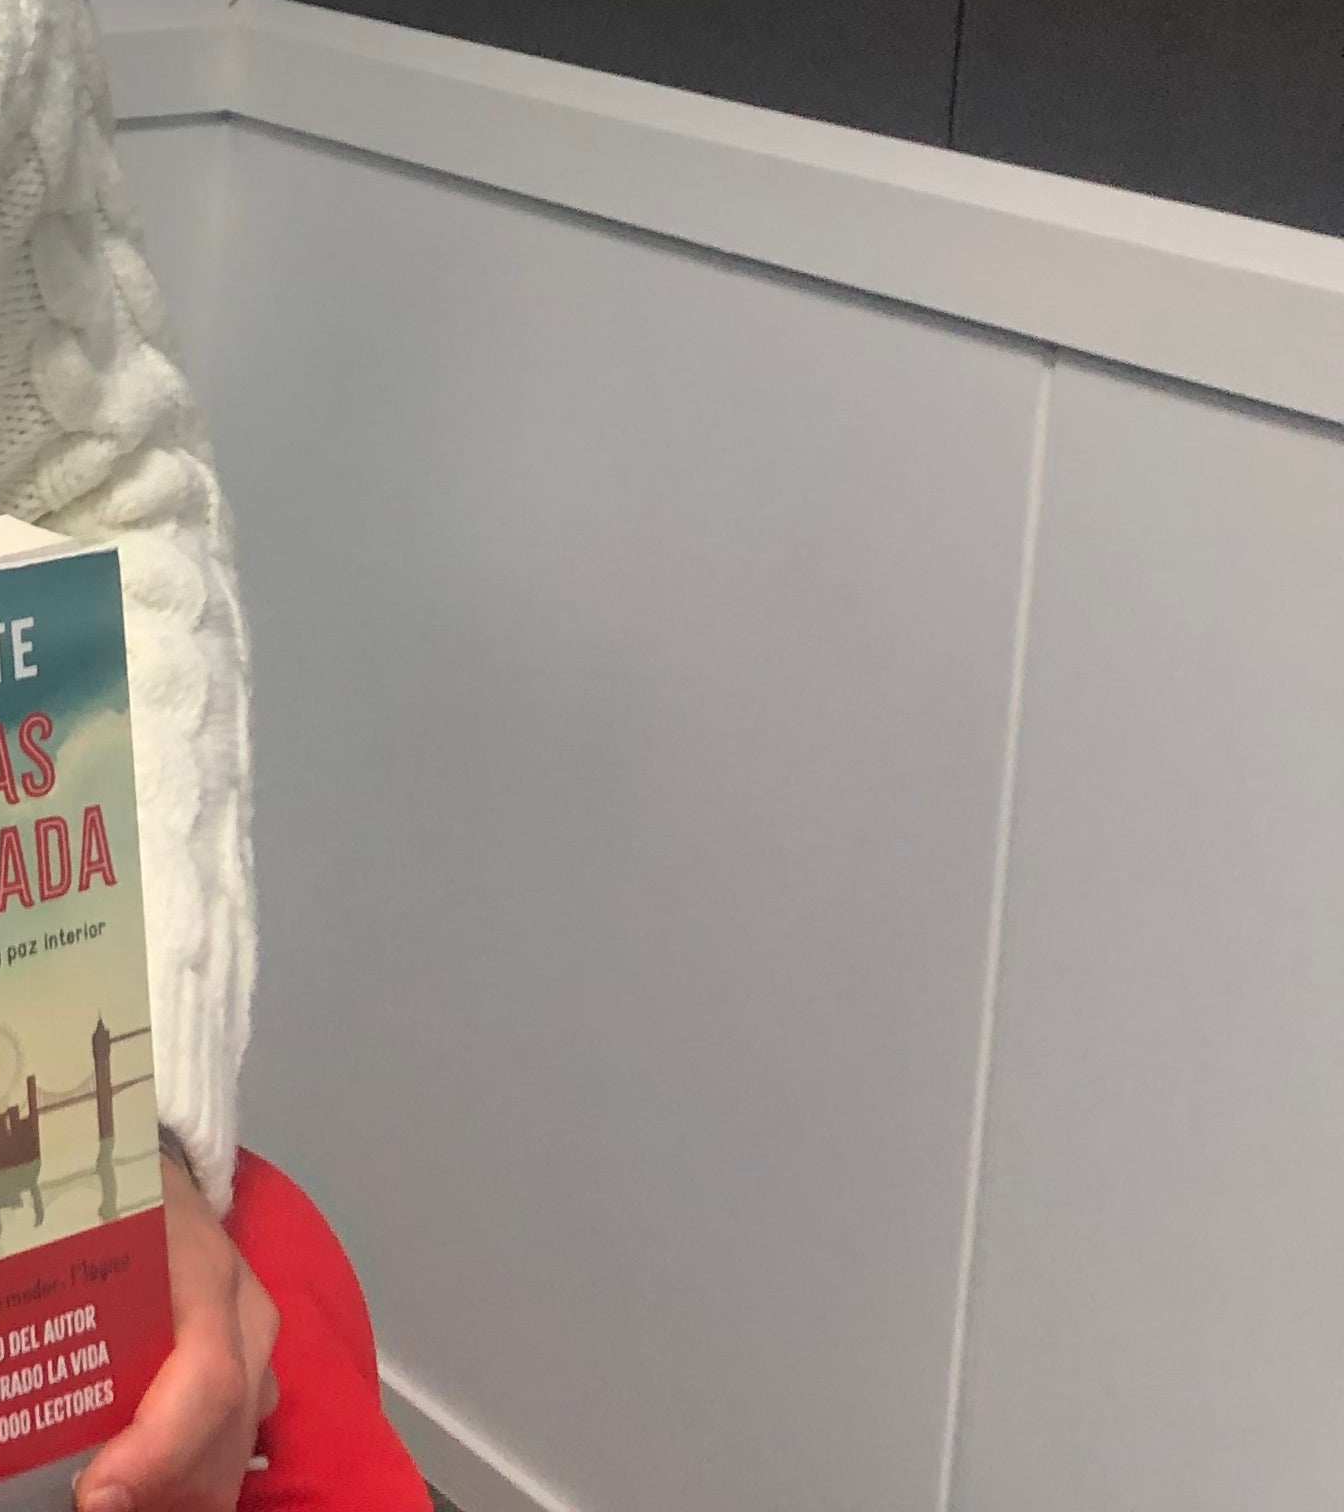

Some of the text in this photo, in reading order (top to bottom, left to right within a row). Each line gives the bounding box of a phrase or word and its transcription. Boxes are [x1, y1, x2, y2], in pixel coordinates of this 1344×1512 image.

[6, 938, 38, 966] paz
[43, 920, 107, 951] interior
[9, 1324, 41, 1358] DEL
[43, 1304, 98, 1346] AUTOR
[47, 1353, 69, 1385] LA
[69, 1340, 111, 1377] VIDA
[34, 1378, 115, 1430] LECTORES
